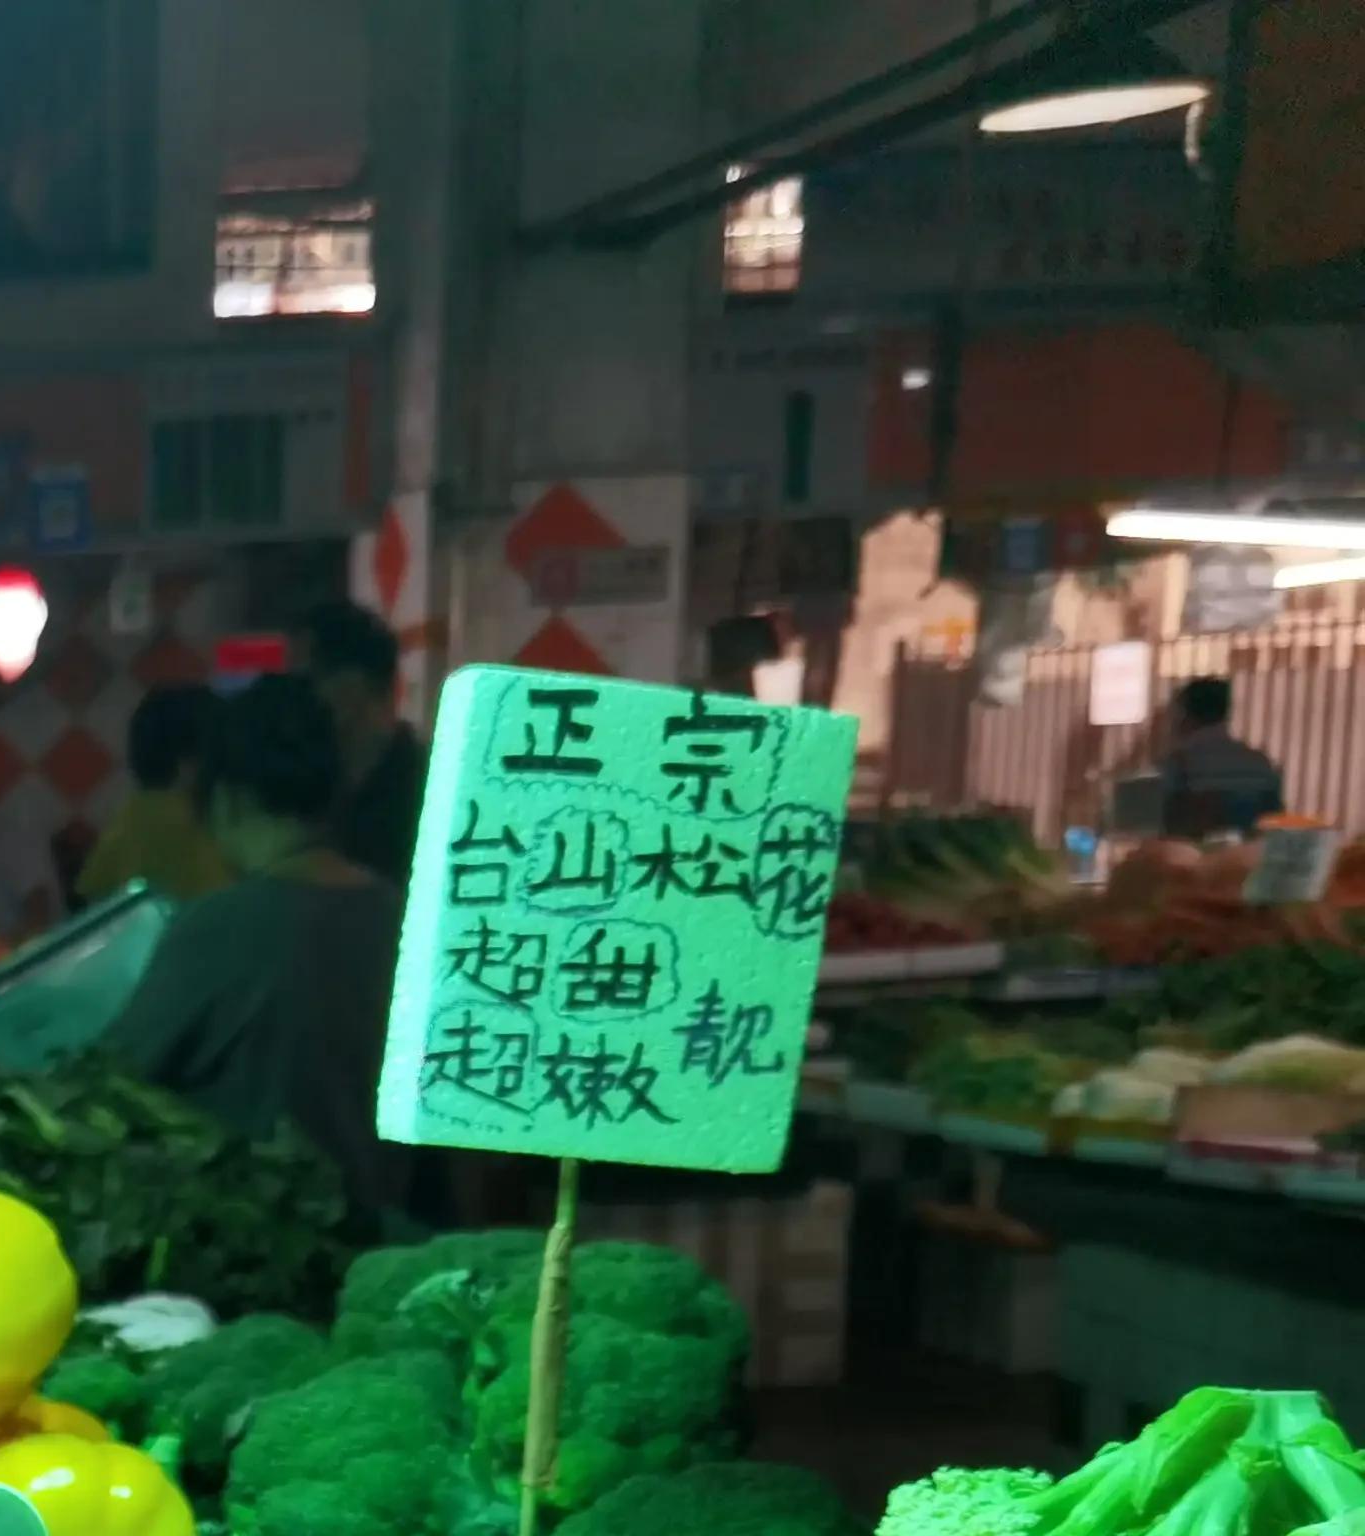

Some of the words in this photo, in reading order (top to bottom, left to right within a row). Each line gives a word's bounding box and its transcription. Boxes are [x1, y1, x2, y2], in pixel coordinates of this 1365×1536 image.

[500, 688, 766, 814] 正宗
[447, 802, 836, 935] 台山松花
[445, 915, 660, 1012] 超甜
